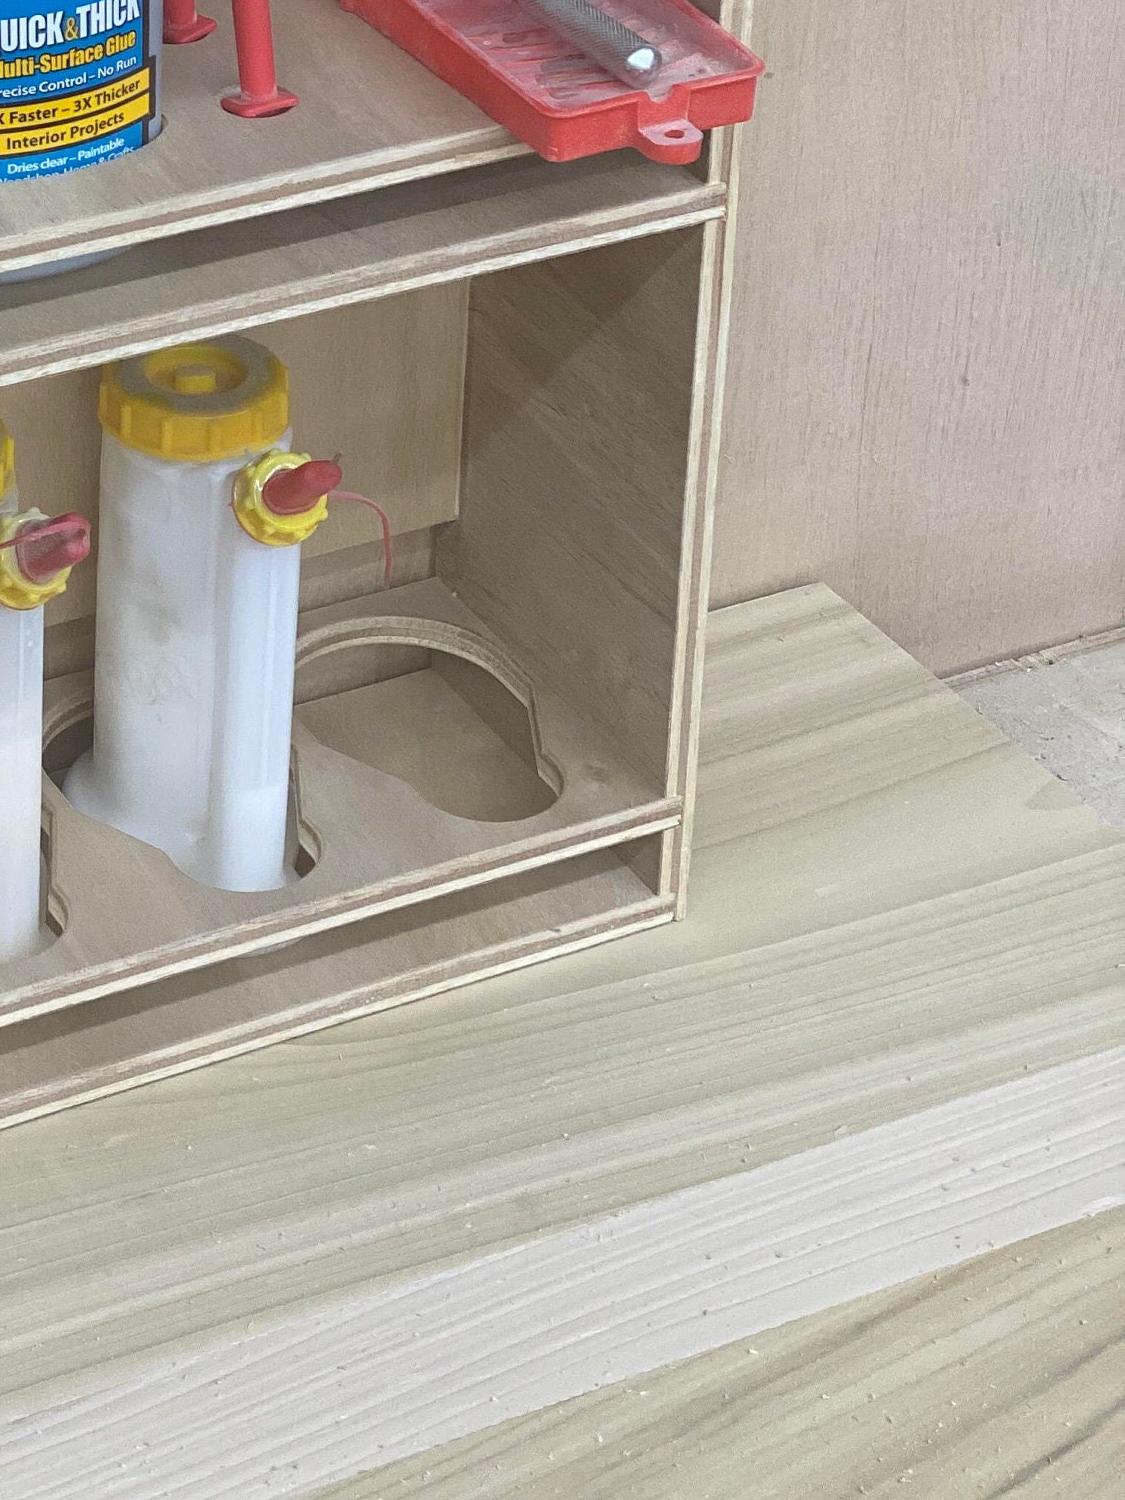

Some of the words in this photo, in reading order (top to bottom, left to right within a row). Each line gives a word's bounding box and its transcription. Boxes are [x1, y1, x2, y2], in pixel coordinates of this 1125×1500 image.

[105, 30, 137, 56] Glue
[39, 72, 87, 93] Control
[97, 65, 114, 79] No
[116, 56, 137, 72] Run
[9, 106, 59, 125] Faster
[73, 96, 92, 113] 3X
[94, 79, 140, 106] Thicker
[7, 130, 67, 150] Interior
[70, 112, 125, 139] Projects
[7, 161, 39, 175] Dries
[41, 155, 69, 169] clear
[77, 137, 125, 161] Paintable
